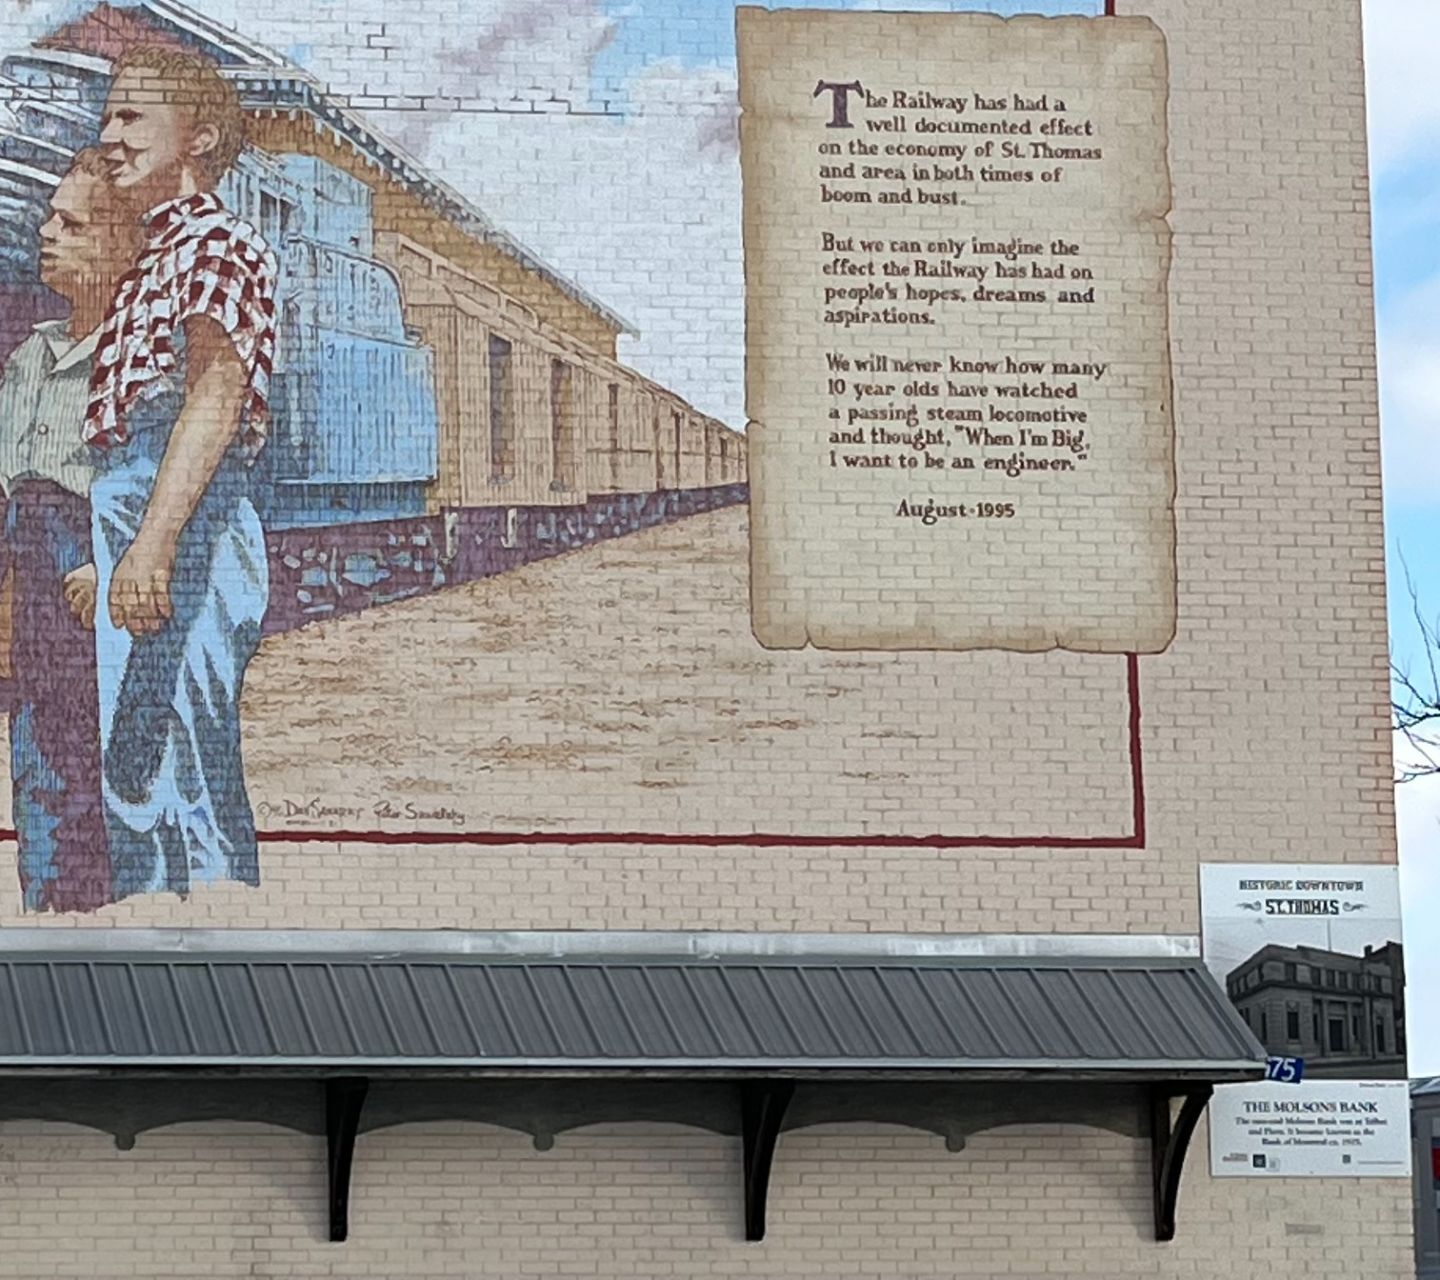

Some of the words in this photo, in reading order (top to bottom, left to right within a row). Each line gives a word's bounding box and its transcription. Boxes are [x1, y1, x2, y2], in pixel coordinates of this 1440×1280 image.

[813, 79, 887, 128] The
[892, 91, 967, 114] Railway
[974, 94, 1007, 111] has
[1013, 94, 1049, 112] had
[1053, 98, 1066, 112] a
[866, 117, 907, 133] well
[915, 117, 1031, 135] documented
[1040, 119, 1094, 137] effect
[818, 142, 841, 155] on
[848, 139, 879, 156] the
[885, 142, 967, 162] economy
[974, 140, 994, 158] of
[1029, 142, 1103, 160] Thomas
[819, 163, 855, 179] and
[862, 167, 905, 180] area
[913, 163, 931, 180] in
[933, 164, 974, 182] both
[980, 164, 1034, 183] times
[1040, 167, 1063, 183] of
[821, 184, 872, 203] boom
[878, 187, 911, 204] and
[917, 187, 967, 205] bust.
[822, 232, 854, 252] But
[859, 239, 884, 252] we
[890, 240, 922, 253] can
[927, 238, 965, 259] only
[972, 236, 1043, 260] imagine
[1050, 239, 1080, 256] the
[822, 259, 876, 276] effect
[882, 260, 910, 277] the
[914, 260, 989, 282] Railway
[995, 261, 1027, 279] has
[1031, 262, 1065, 279] had
[1070, 268, 1094, 280] on
[824, 282, 898, 305] people's
[906, 283, 965, 305] hopes,
[973, 285, 1047, 302] dreams
[1057, 287, 1095, 303] and
[823, 306, 935, 328] aspirations.
[826, 352, 850, 372] We
[854, 354, 887, 372] will
[893, 360, 942, 373] never
[950, 355, 998, 373] know
[1005, 356, 1045, 374] how
[1052, 362, 1107, 380] many
[828, 378, 845, 395] 10
[853, 383, 896, 401] year
[903, 381, 939, 397] olds
[948, 381, 988, 397] have
[995, 382, 1078, 399] watched
[829, 408, 840, 420] a
[848, 403, 920, 427] passing
[927, 408, 983, 422] steam
[989, 405, 1088, 423] locomotive
[829, 427, 865, 445] and
[871, 428, 952, 451] thought,
[955, 425, 1015, 446] "When
[1019, 429, 1048, 447] I'm
[830, 450, 837, 467] I
[843, 454, 893, 468] want
[899, 454, 918, 468] to
[924, 452, 945, 469] be
[951, 457, 975, 469] an
[1240, 880, 1293, 890] HISTORIC
[1296, 880, 1363, 891] DOWNTOWN
[1244, 1102, 1270, 1113] THE
[1274, 1102, 1337, 1113] MOLSONS
[1340, 1102, 1378, 1113] BANK
